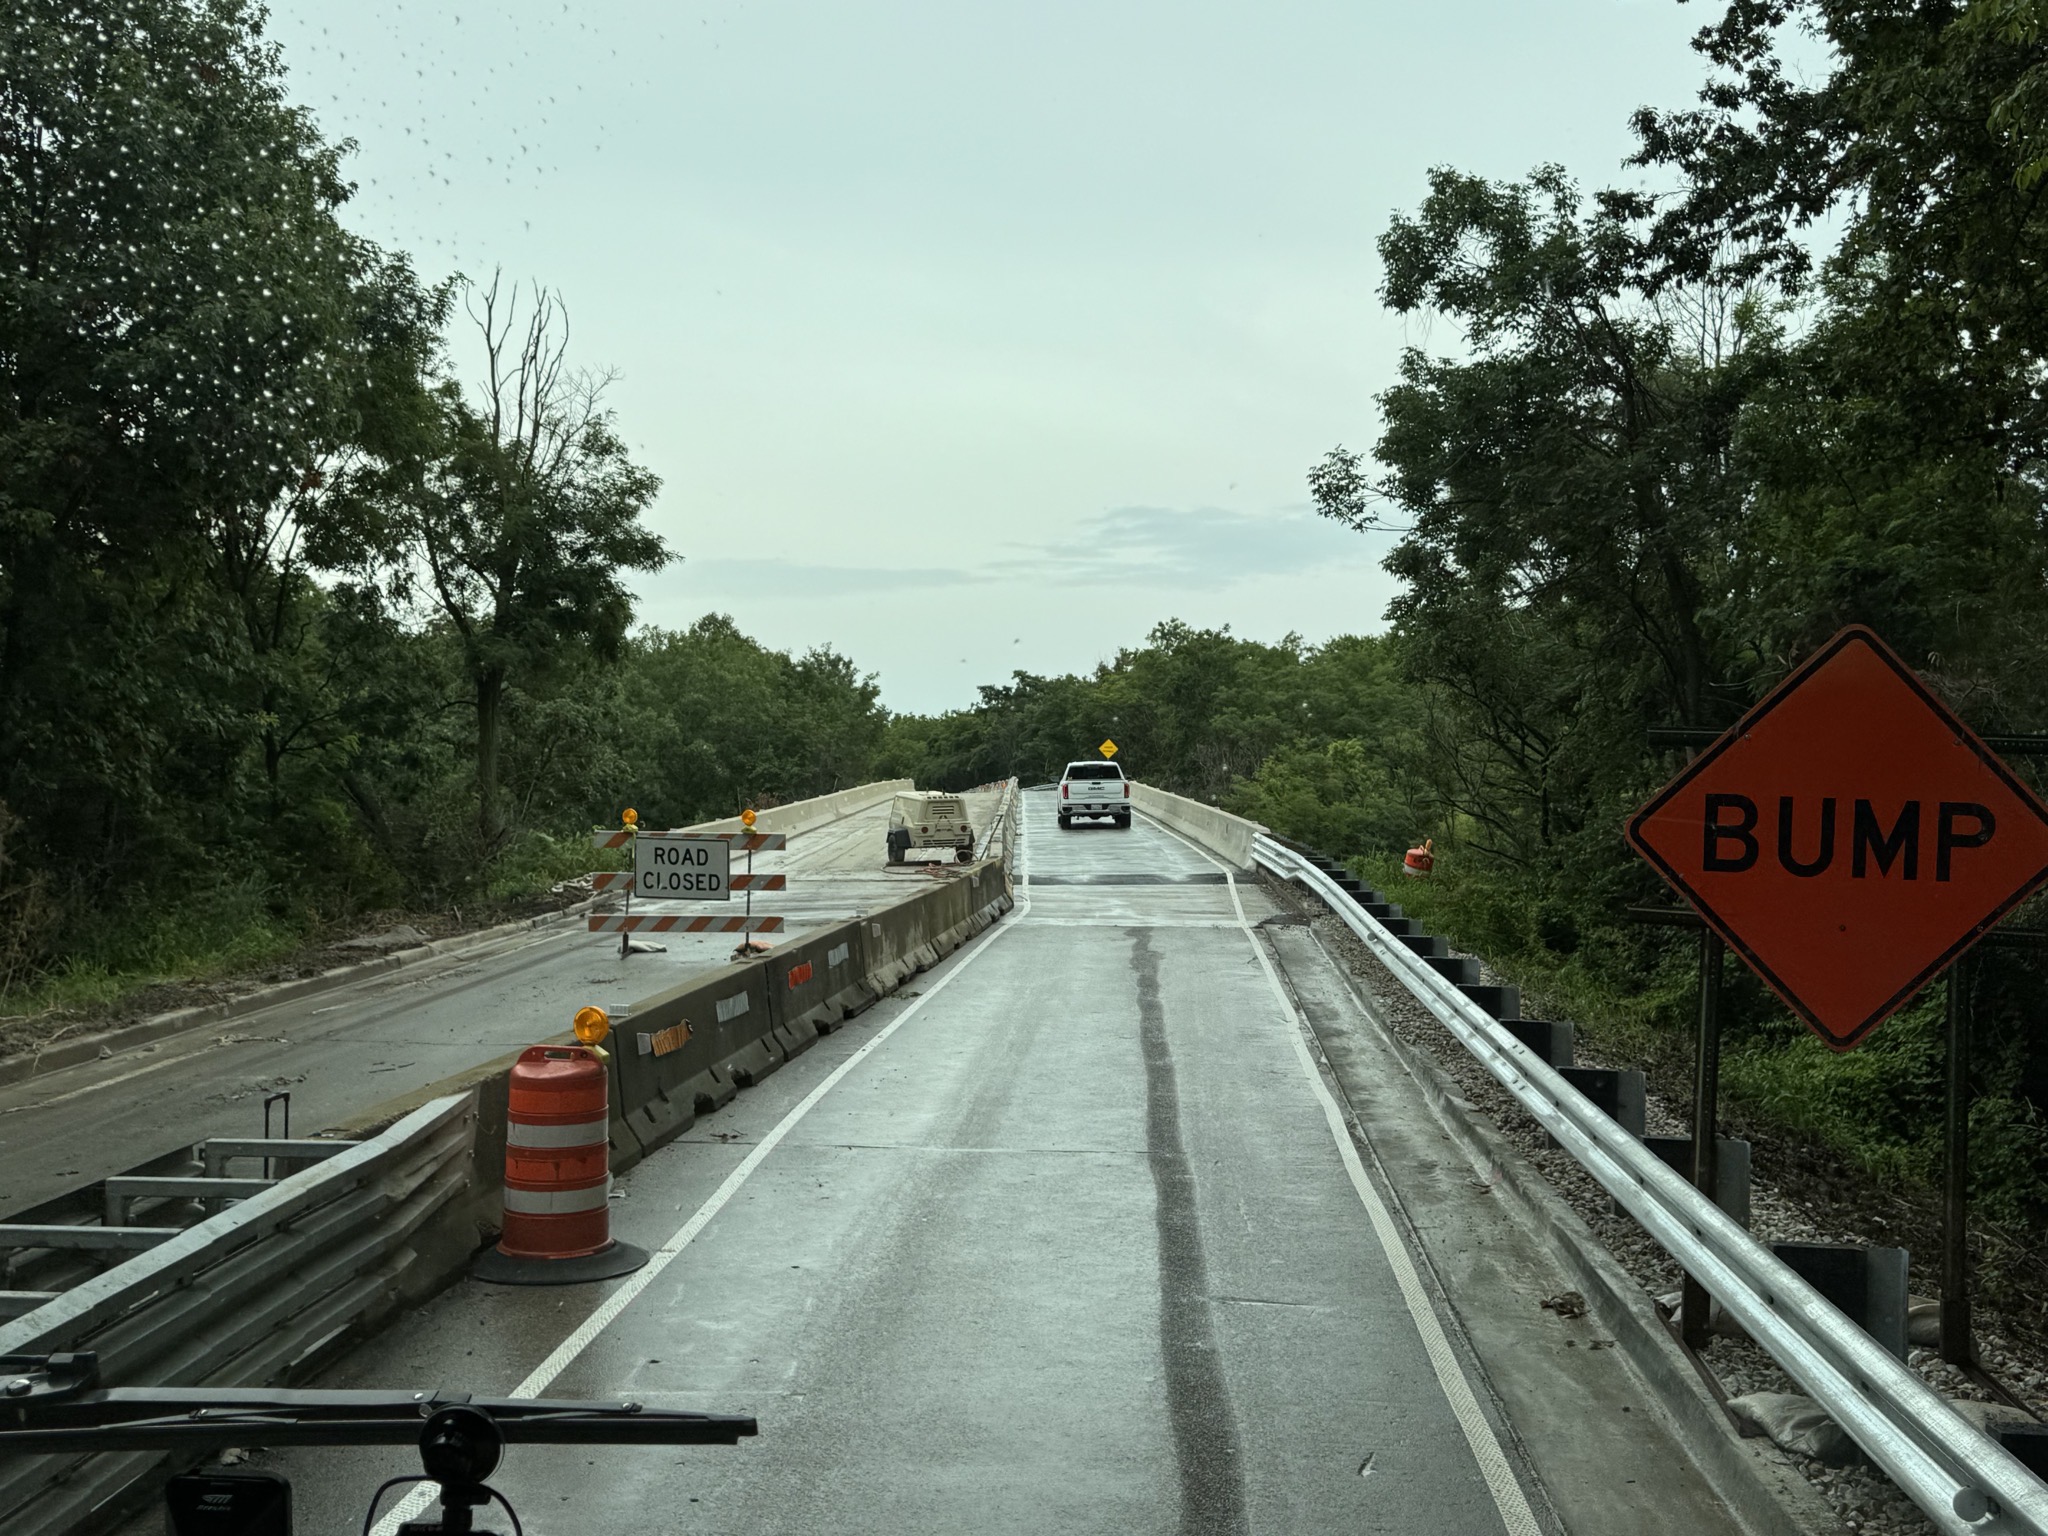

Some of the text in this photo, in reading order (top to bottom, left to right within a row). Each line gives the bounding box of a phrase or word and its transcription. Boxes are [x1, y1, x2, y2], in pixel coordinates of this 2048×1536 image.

[1702, 793, 1997, 882] BUMP
[654, 847, 709, 866] ROAD
[643, 871, 721, 891] CLOSED
